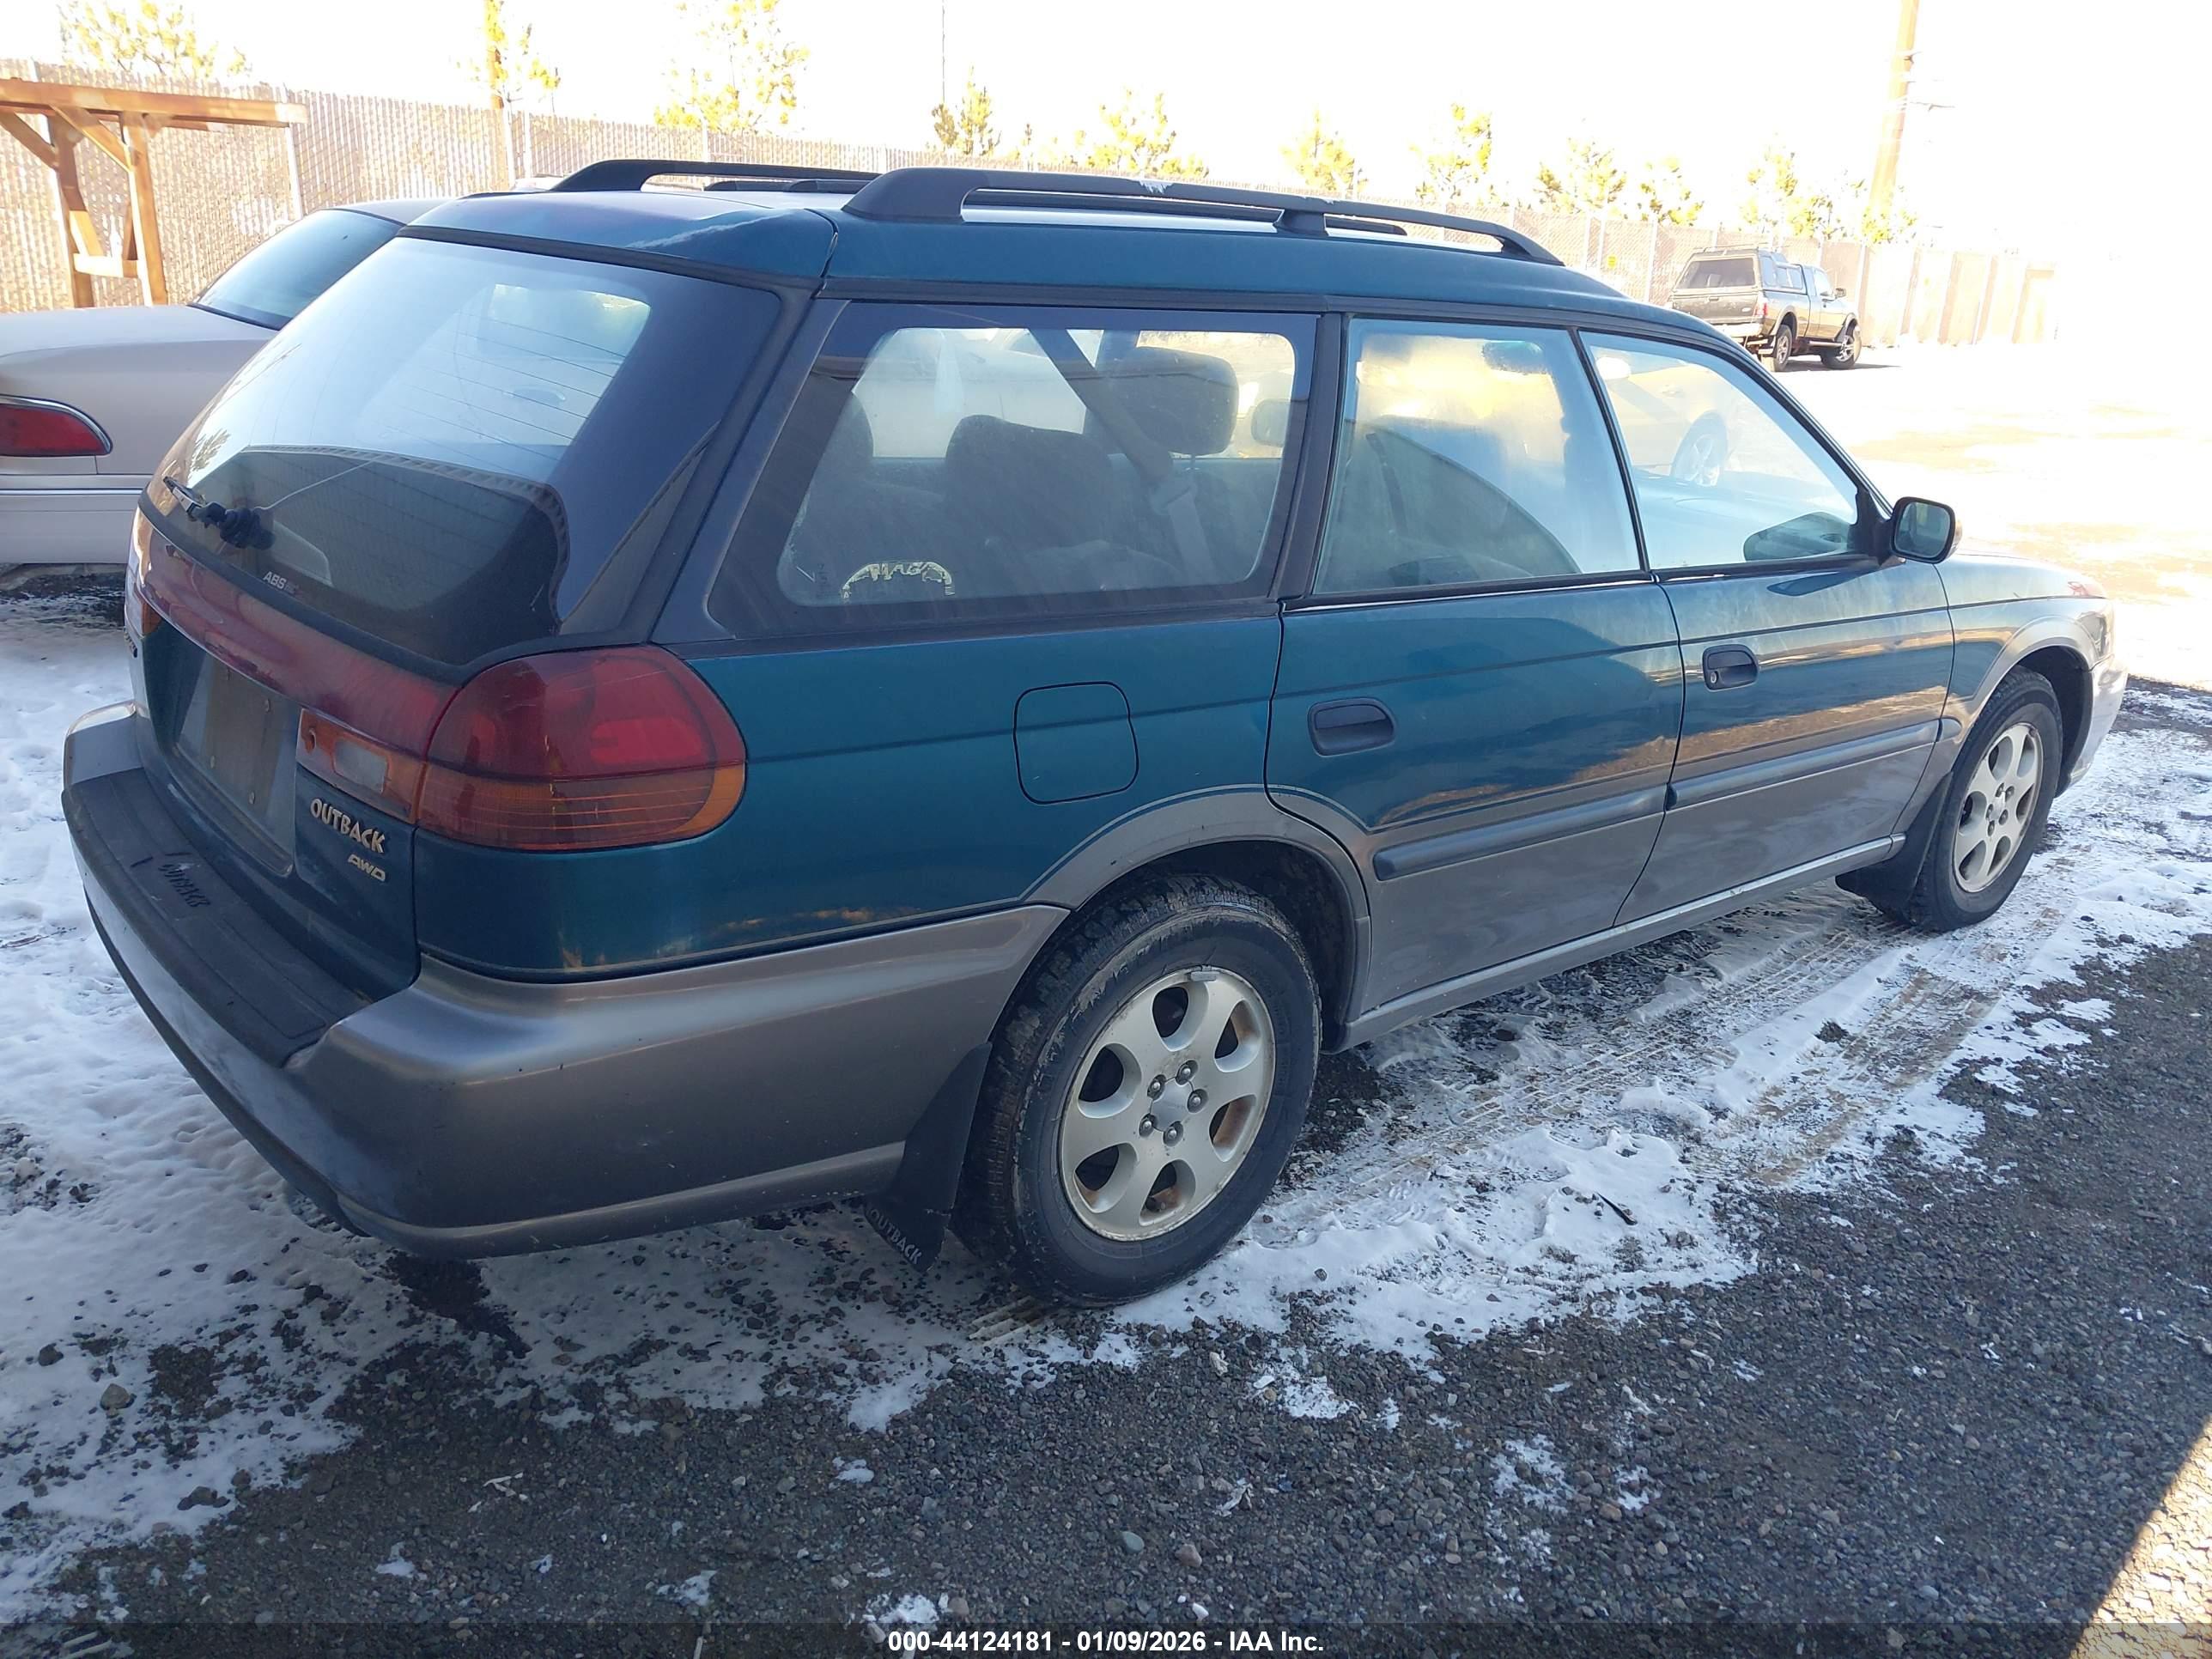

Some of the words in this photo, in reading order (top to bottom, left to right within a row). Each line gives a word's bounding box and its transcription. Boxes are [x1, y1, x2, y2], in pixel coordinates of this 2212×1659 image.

[263, 571, 287, 589] ABS
[310, 798, 386, 854] OUTBACK
[347, 854, 386, 882] AWD
[870, 1208, 922, 1265] OUTBACK
